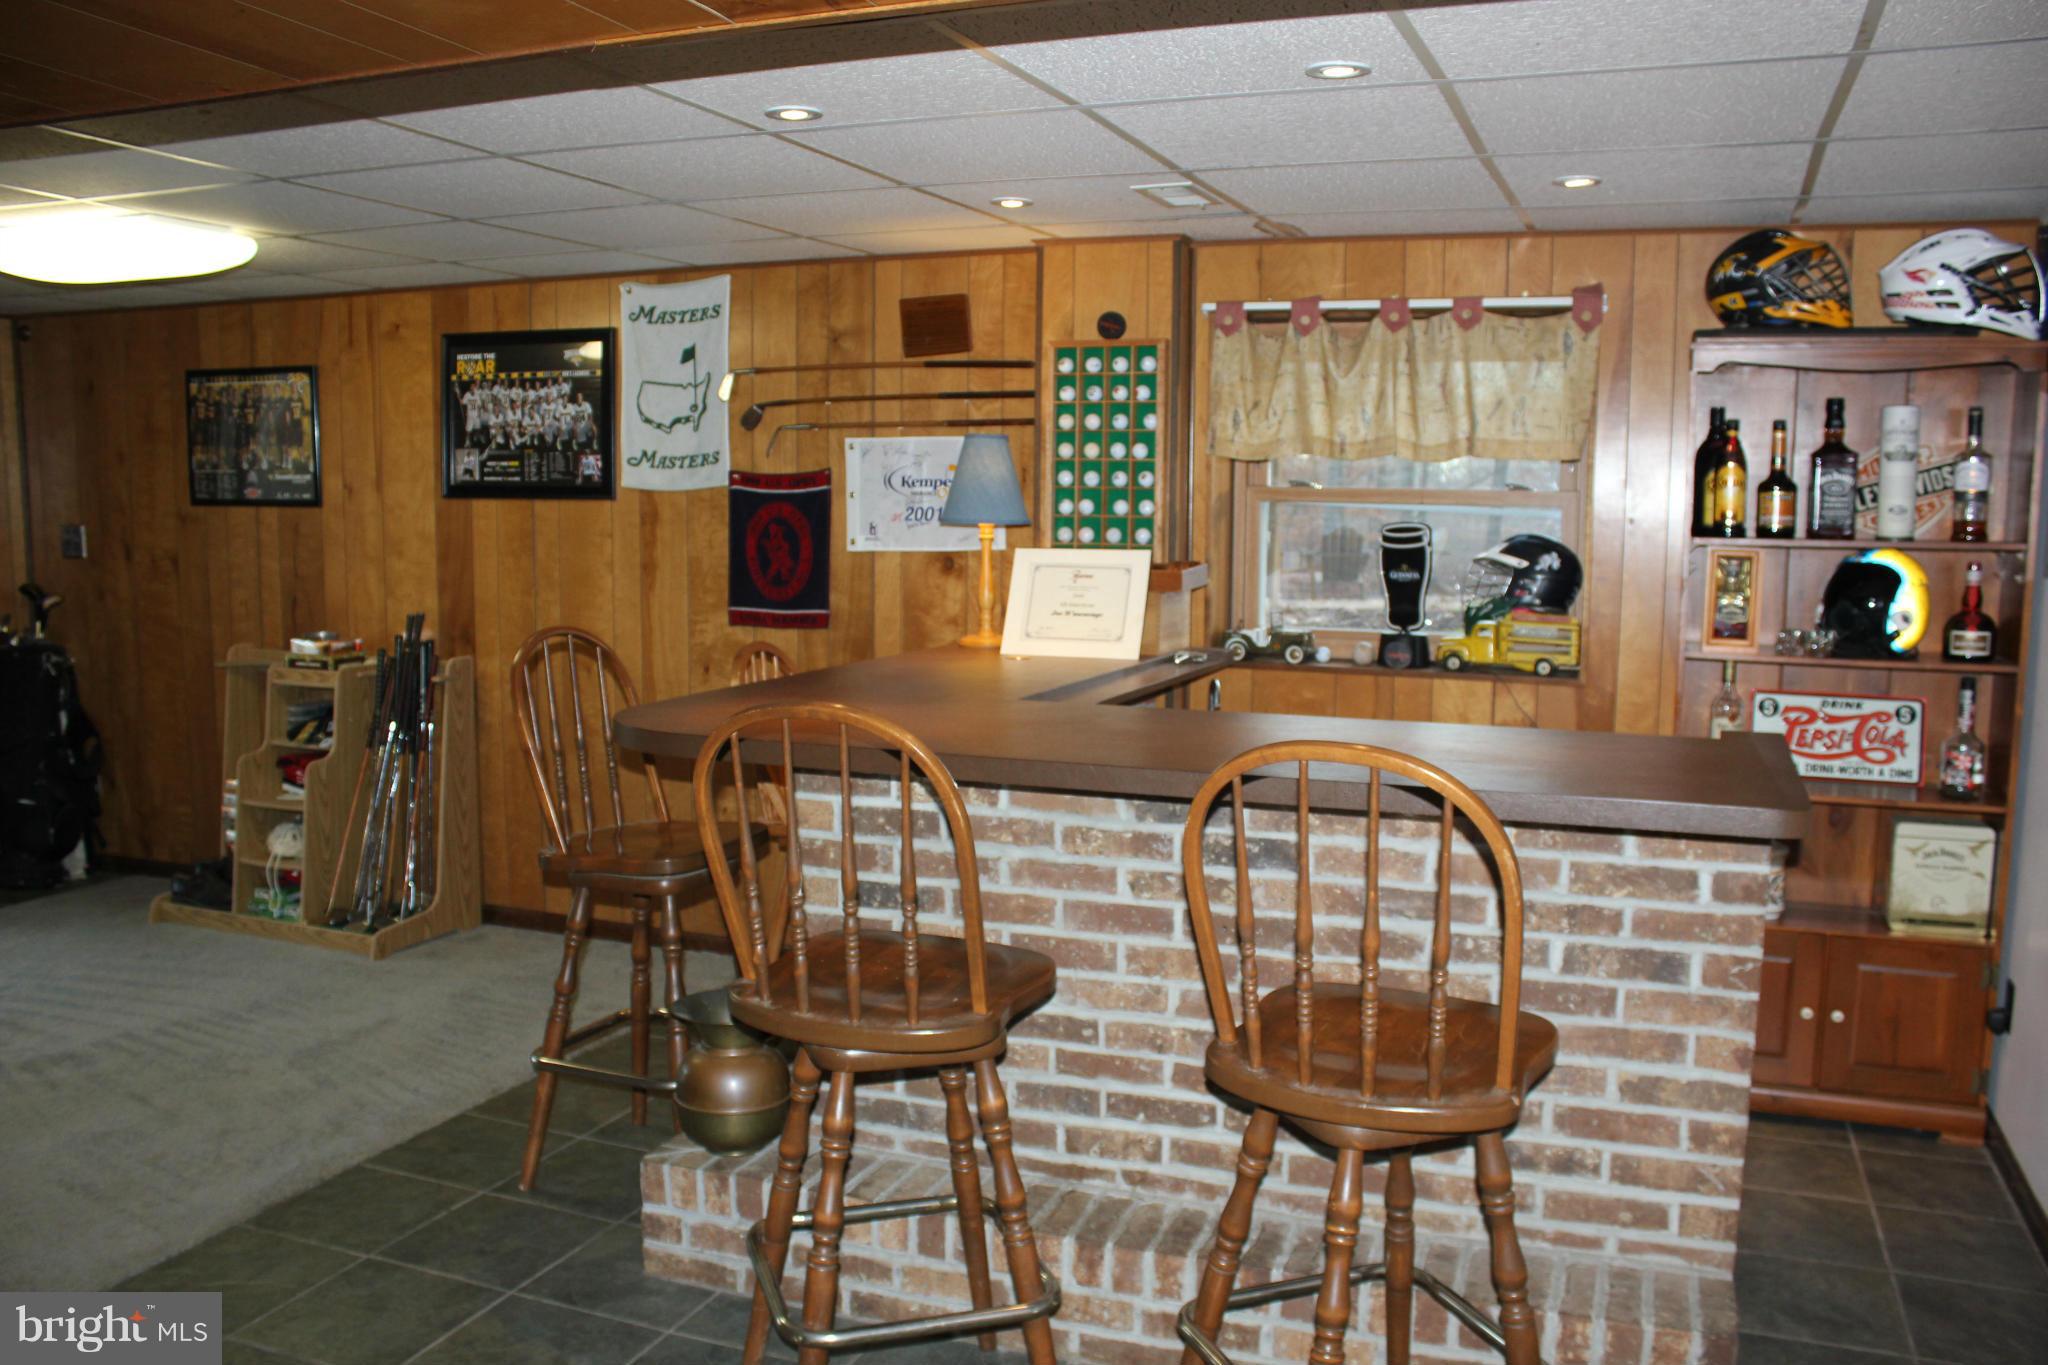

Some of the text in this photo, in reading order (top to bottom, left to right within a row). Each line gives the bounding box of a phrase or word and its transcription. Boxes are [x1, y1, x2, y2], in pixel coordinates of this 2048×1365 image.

[628, 303, 722, 325] MASTERS
[626, 448, 720, 469] MASTERS
[901, 474, 952, 490] Kempe
